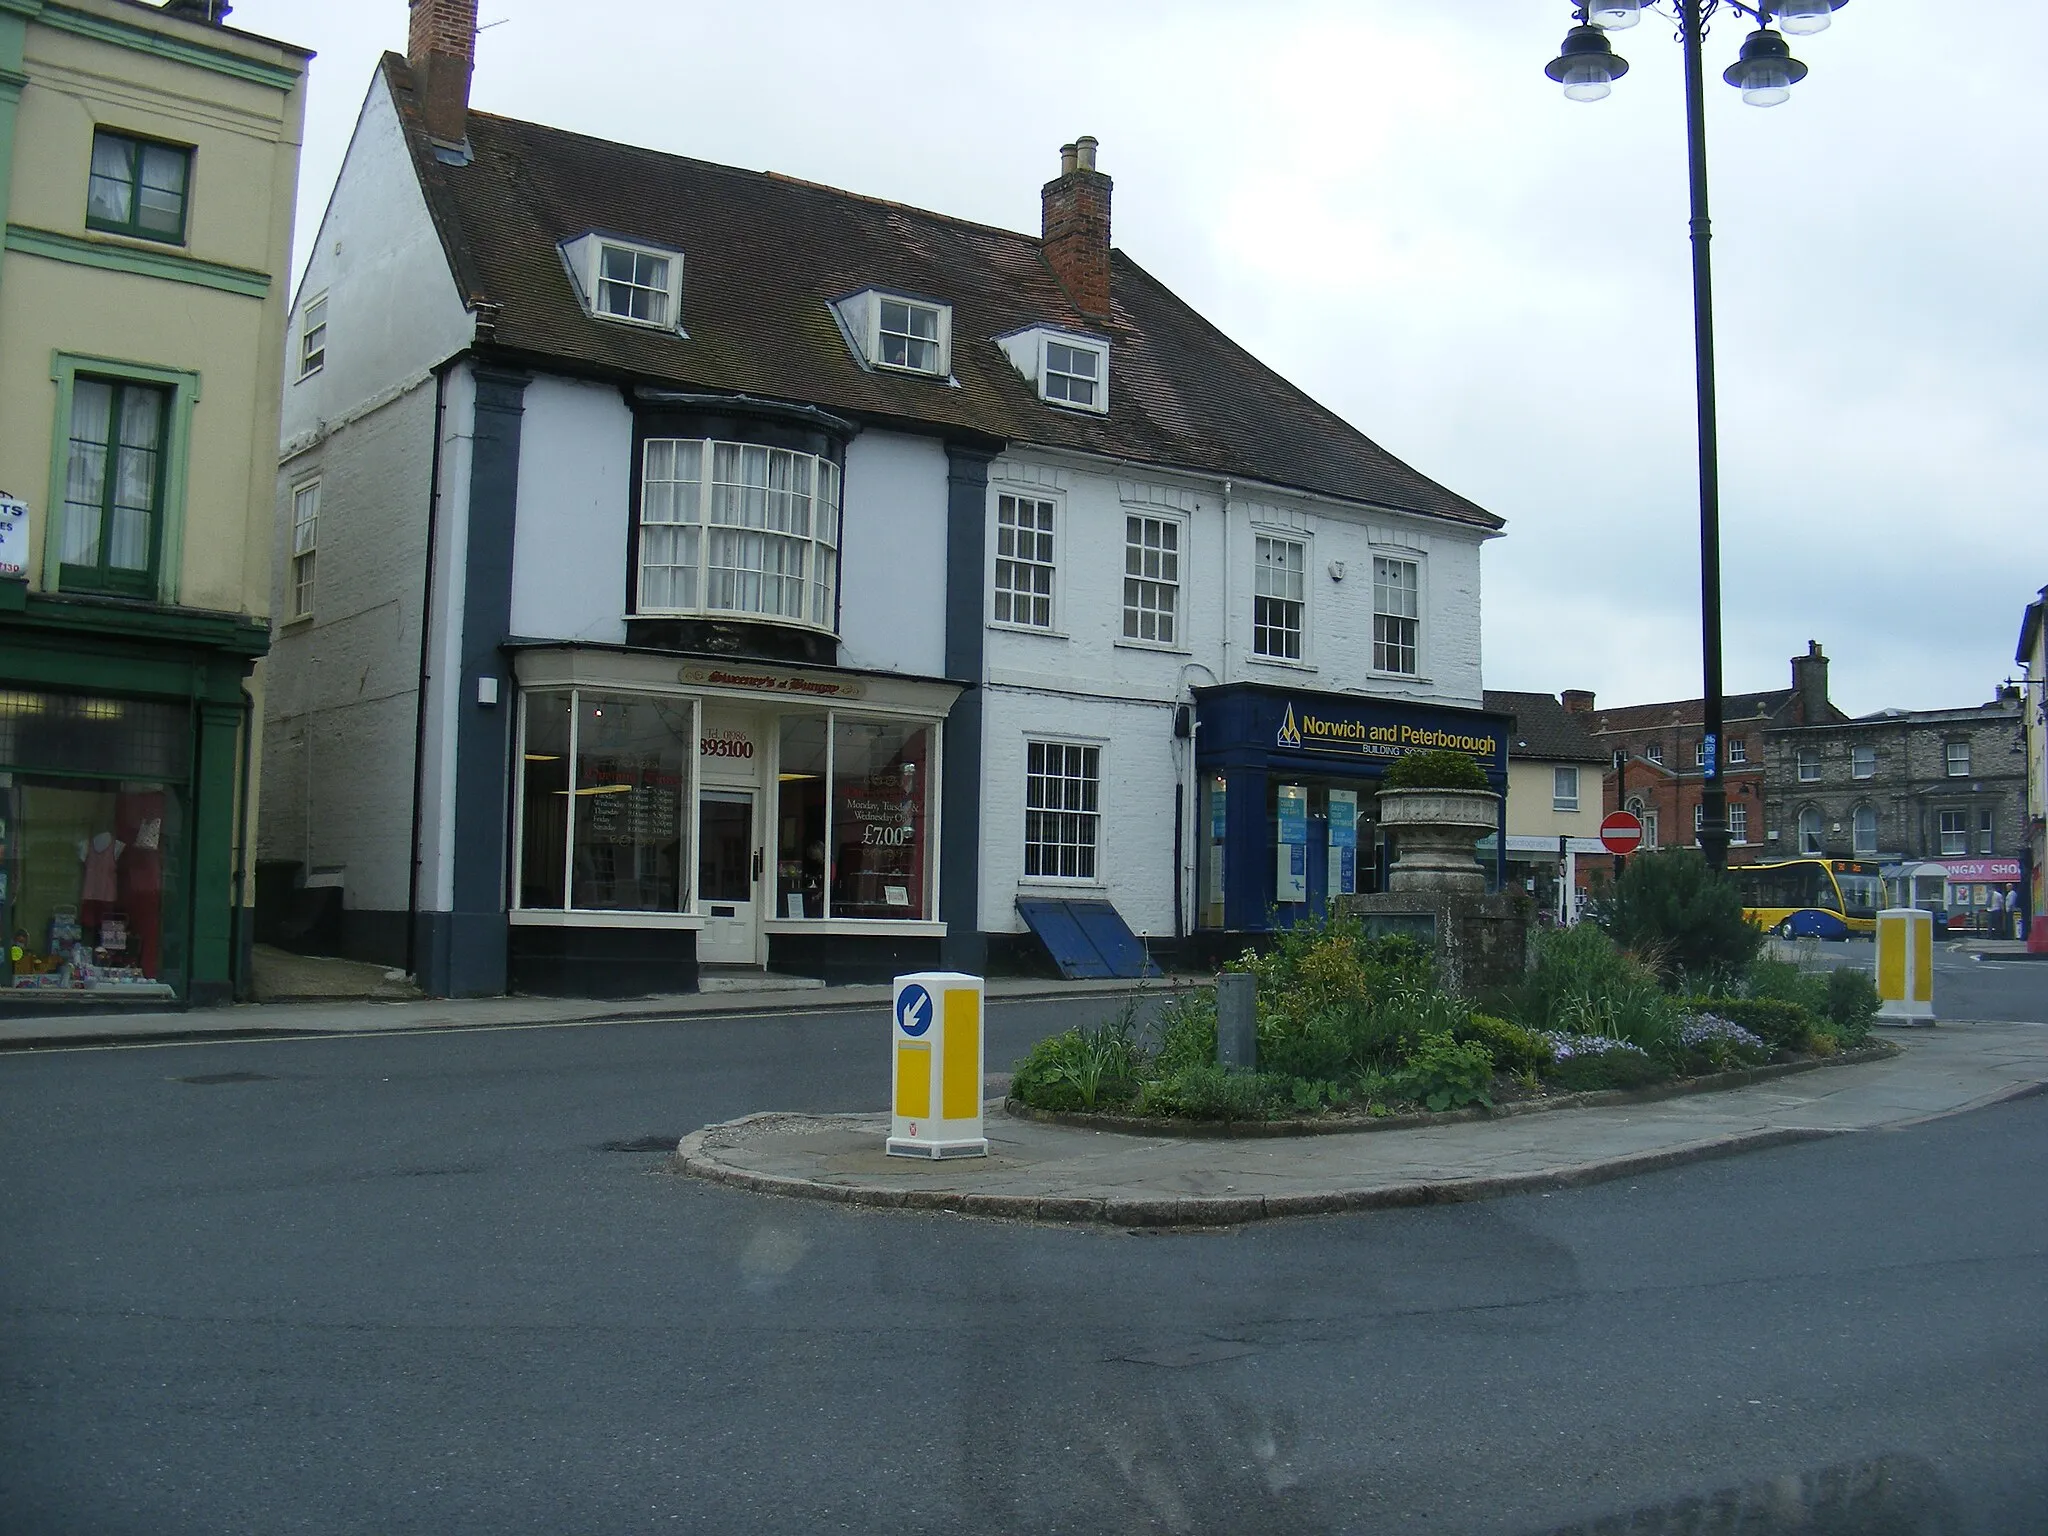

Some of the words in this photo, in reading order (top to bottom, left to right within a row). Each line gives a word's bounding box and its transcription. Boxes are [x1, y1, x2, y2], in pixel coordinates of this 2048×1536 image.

[1303, 715, 1365, 739] Norwich
[1369, 725, 1397, 742] and
[1401, 726, 1496, 756] Peterborough
[1363, 744, 1400, 756] BUILDING
[854, 811, 893, 824] Wednesday
[861, 824, 904, 846] £7.00
